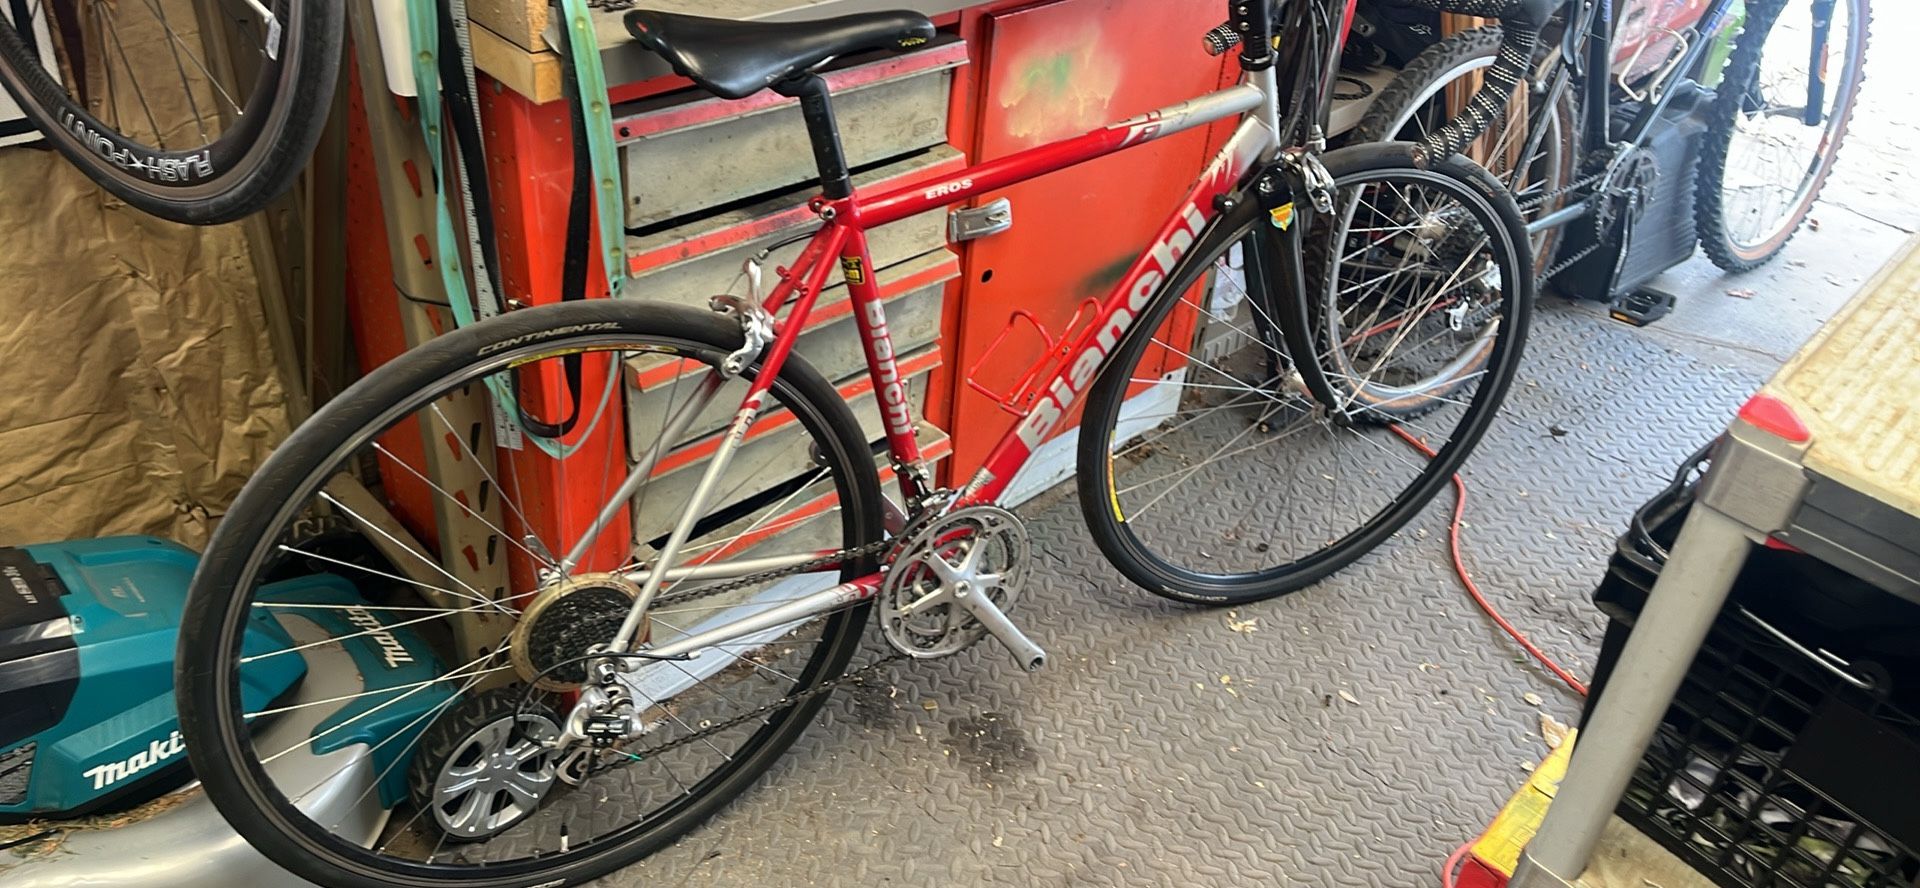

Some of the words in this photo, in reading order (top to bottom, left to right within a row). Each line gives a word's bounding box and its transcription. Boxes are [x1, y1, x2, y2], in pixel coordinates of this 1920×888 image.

[146, 150, 214, 181] FLASH
[925, 179, 973, 199] EROS
[477, 322, 622, 356] CONTINENTAL
[1016, 202, 1206, 450] Bianchi
[865, 298, 912, 435] Bianchi
